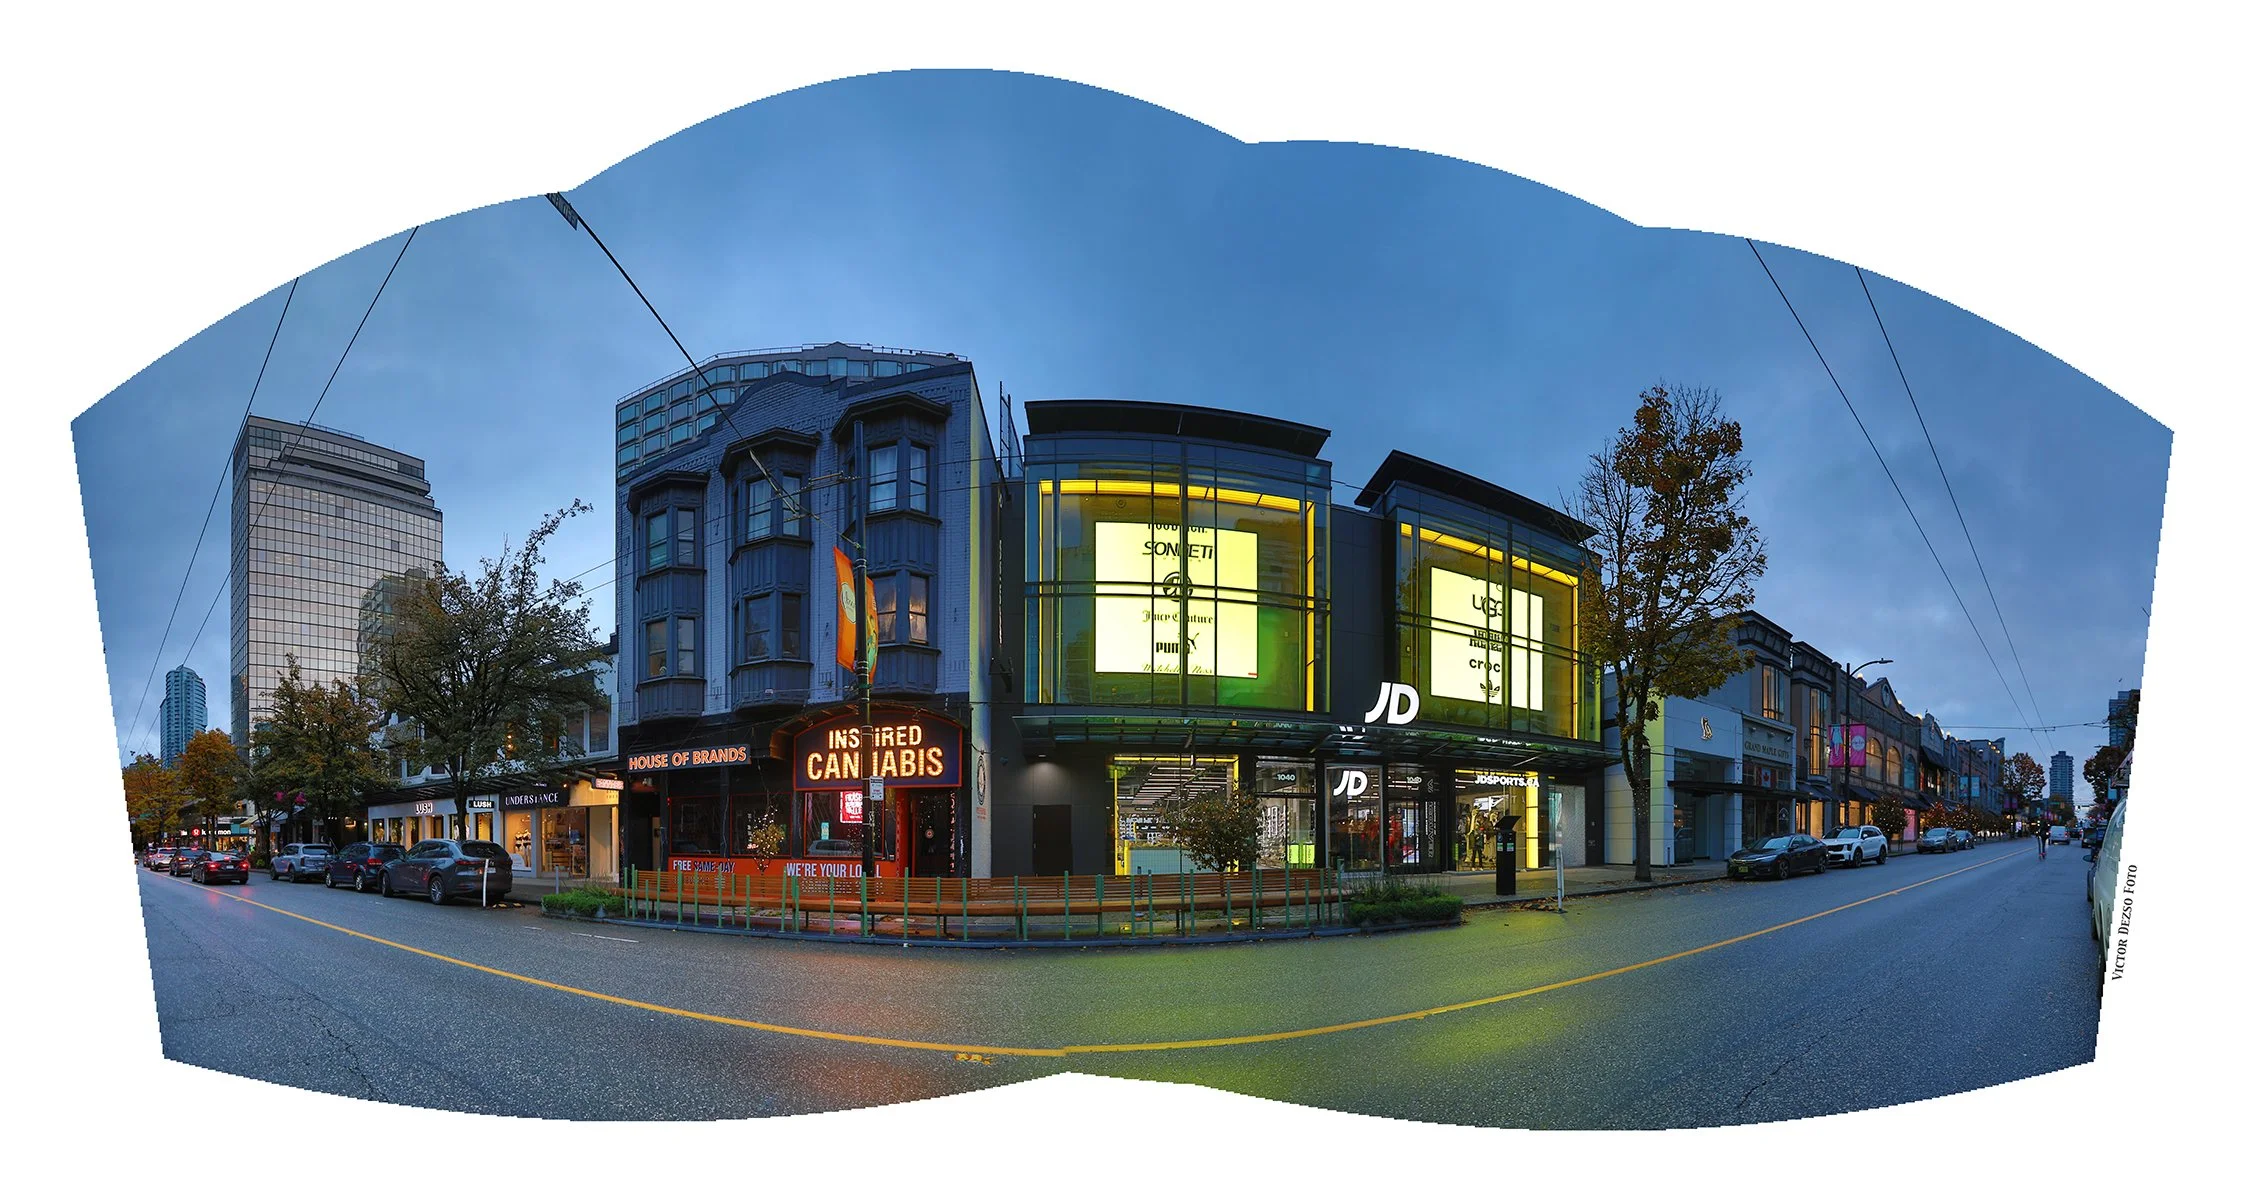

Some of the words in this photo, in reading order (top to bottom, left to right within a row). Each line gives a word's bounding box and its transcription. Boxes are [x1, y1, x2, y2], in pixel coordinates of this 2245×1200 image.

[1364, 681, 1420, 725] JD
[828, 725, 922, 749] INSIRED
[1744, 740, 1762, 752] GRAND
[629, 754, 668, 770] HOUSE
[671, 752, 690, 766] OF
[692, 747, 746, 765] BRANDS
[1277, 773, 1296, 781] 1040
[1333, 770, 1368, 796] JD
[415, 803, 433, 814] LUSH
[673, 860, 692, 870] FREE
[786, 863, 817, 876] WE'RE
[820, 863, 847, 877] YOUR
[849, 864, 882, 878] LOL
